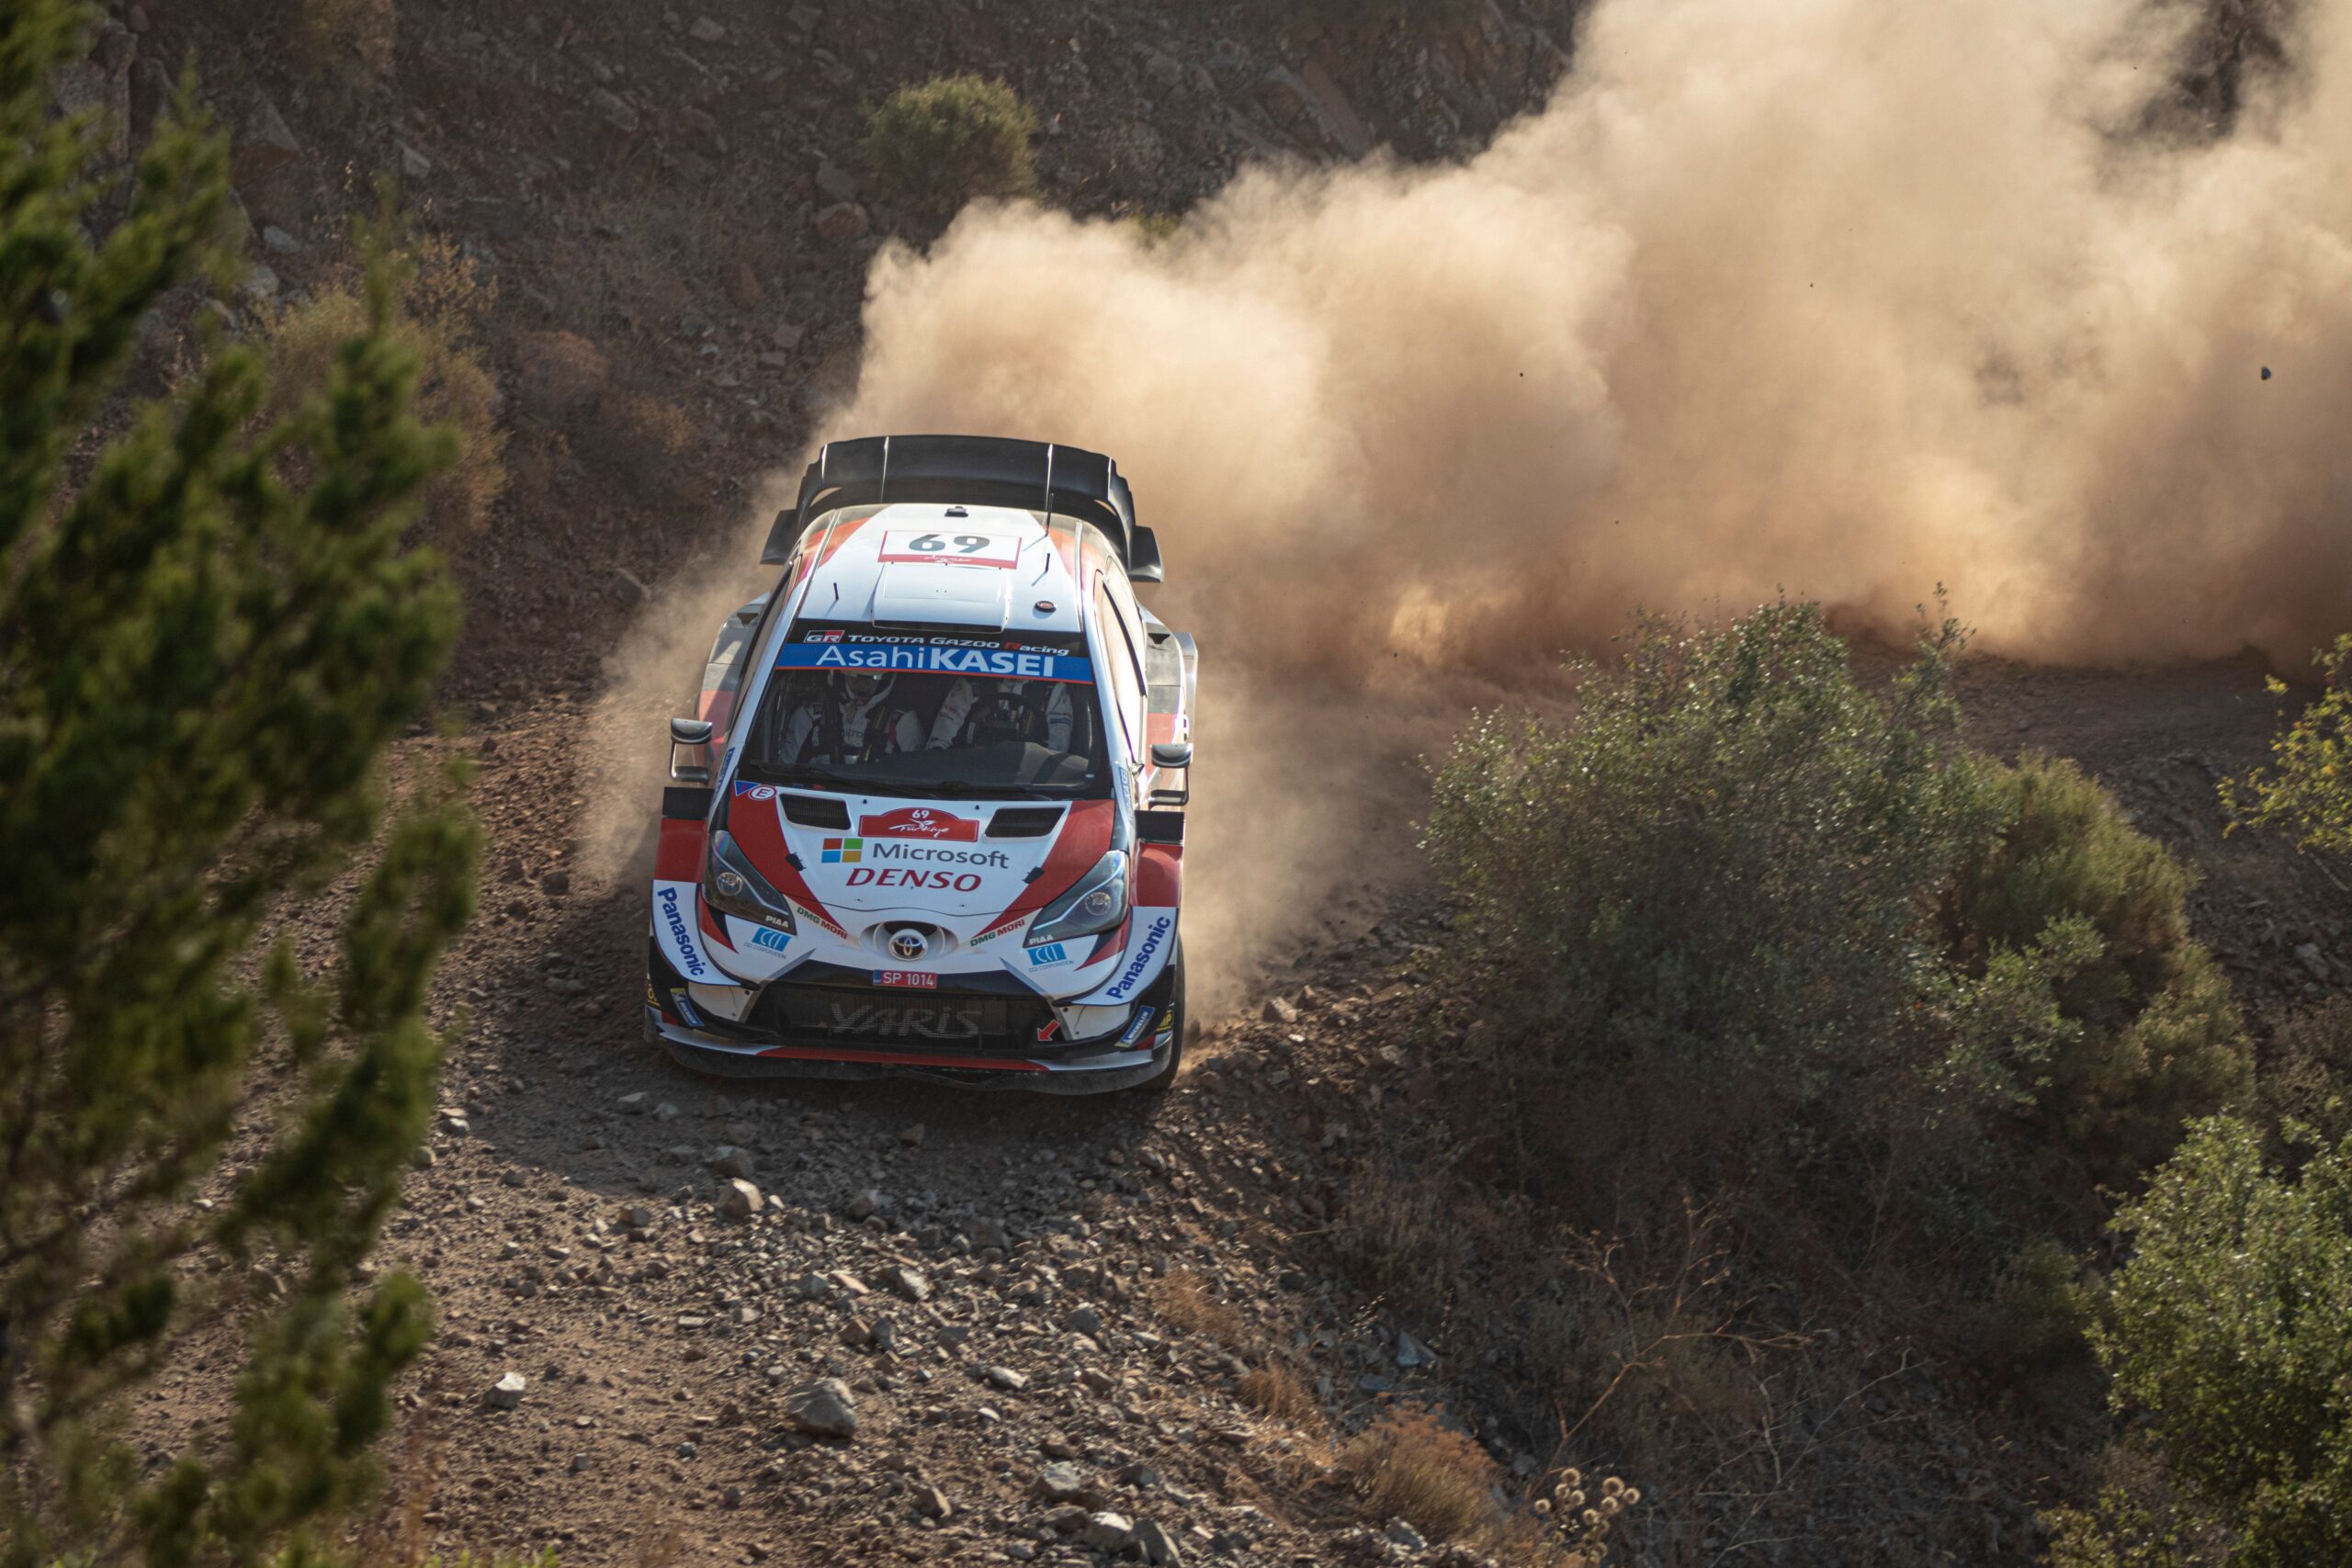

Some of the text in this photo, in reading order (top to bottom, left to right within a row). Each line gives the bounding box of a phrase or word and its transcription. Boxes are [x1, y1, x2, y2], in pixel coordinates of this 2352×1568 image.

[909, 534, 990, 554] 69
[806, 633, 1069, 656] GR TOYOTA GAZOO Racing
[911, 809, 930, 818] 69
[872, 842, 1010, 869] Microsoft
[845, 868, 982, 892] DENSO
[657, 886, 705, 976] Panasonic
[764, 915, 789, 928] PIAA
[797, 906, 848, 939] DMG MORI
[970, 919, 1025, 947] DMG MORI
[1029, 934, 1054, 945] PIAA
[1105, 916, 1170, 999] Panasonic
[883, 972, 934, 987] SP 1014
[831, 1003, 982, 1038] YARIS
